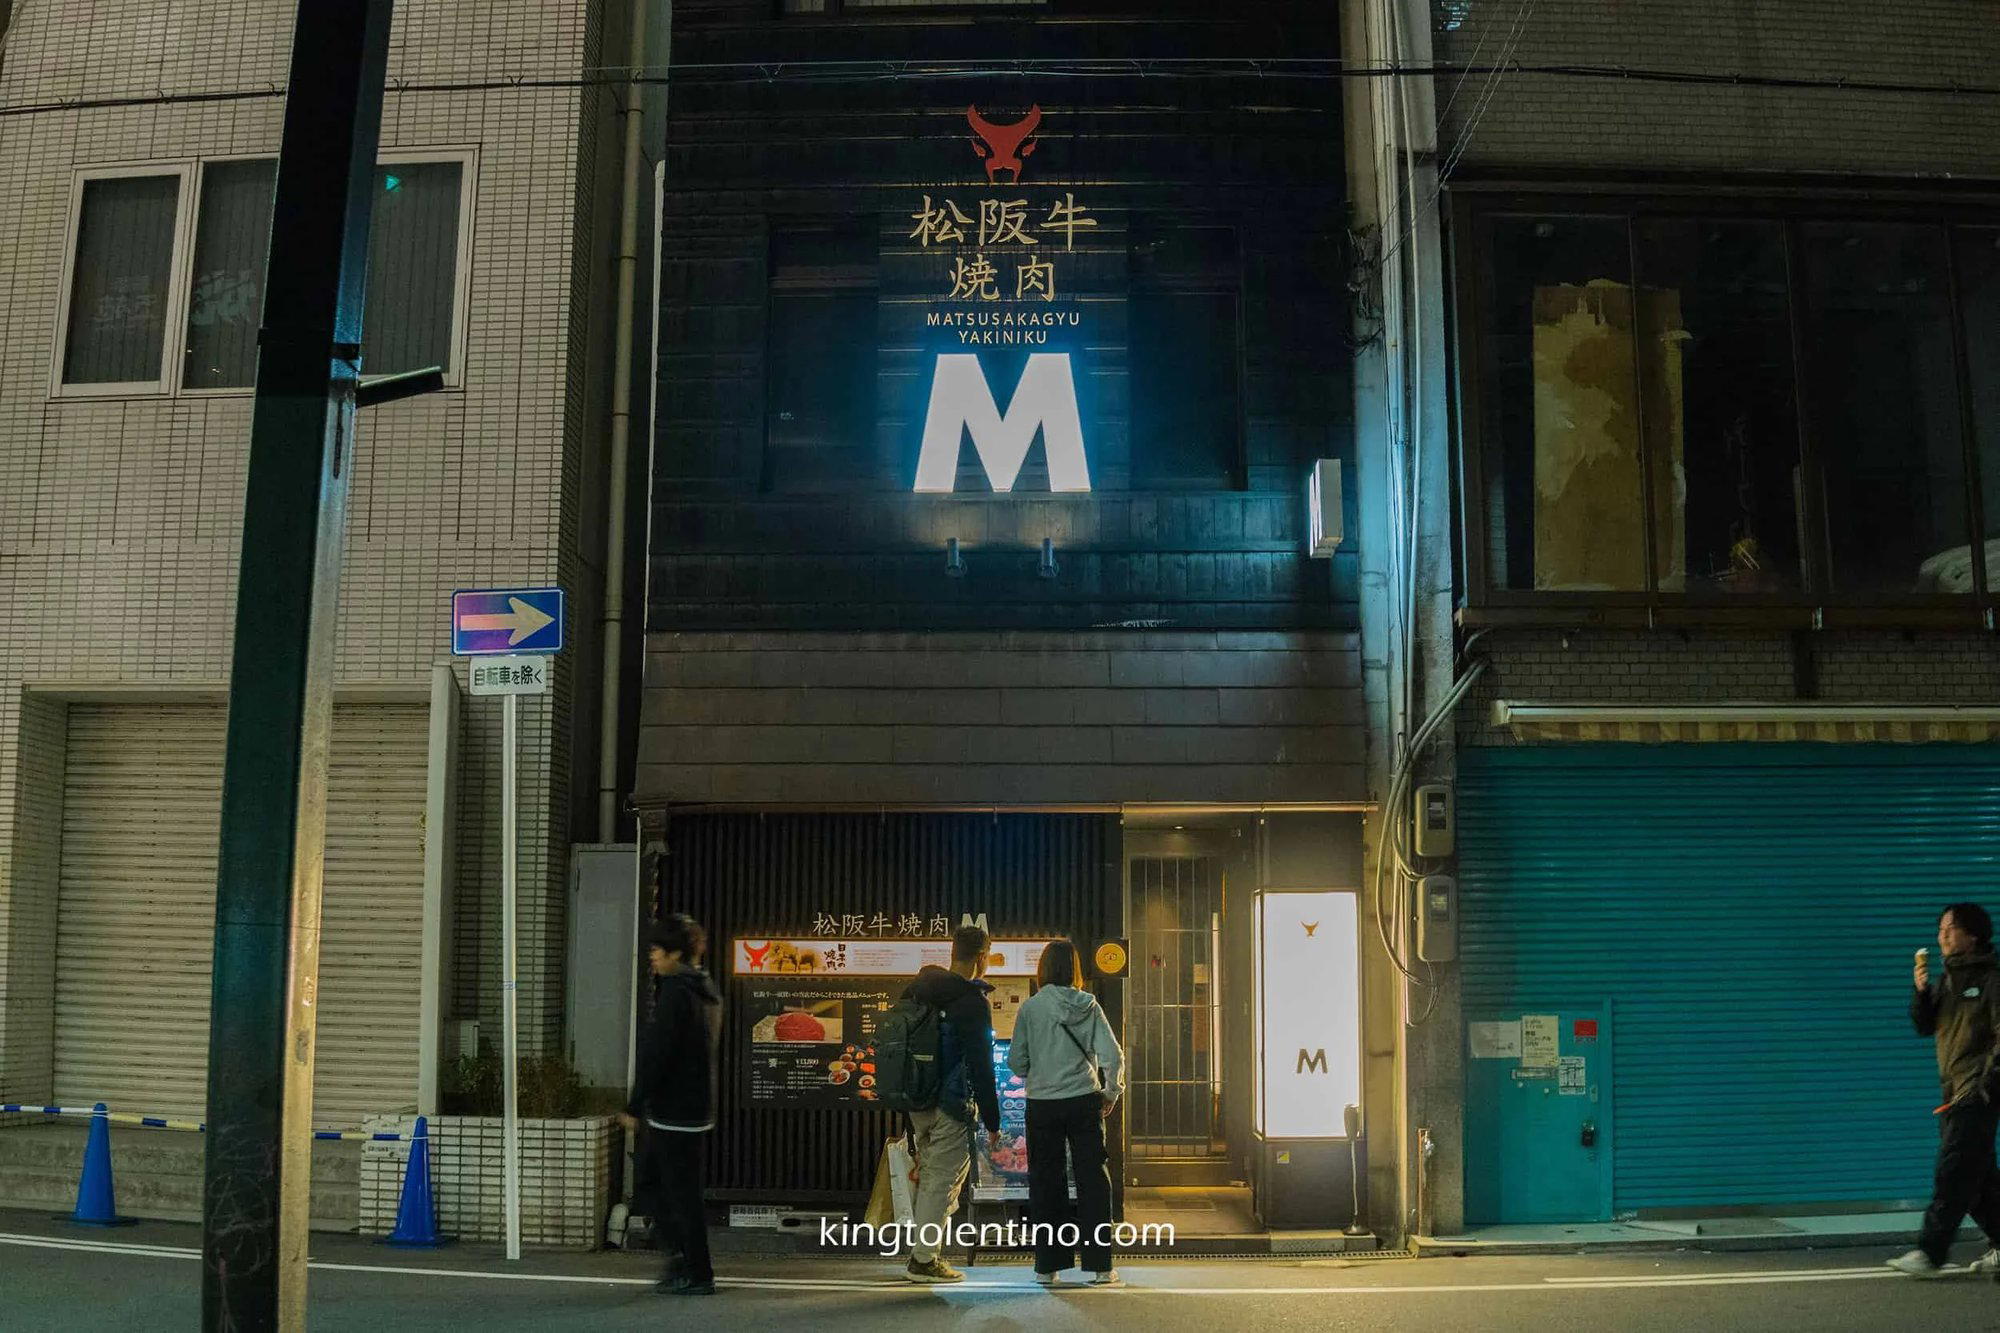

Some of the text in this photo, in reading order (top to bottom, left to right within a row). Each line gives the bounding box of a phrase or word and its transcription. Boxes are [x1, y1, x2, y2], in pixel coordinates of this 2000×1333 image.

[910, 193, 1097, 251] 松阪牛
[948, 254, 1055, 303] 焼肉
[927, 312, 1080, 326] MATSUSAKAGYU
[958, 330, 1047, 344] YAKINIKU
[913, 352, 1092, 493] M
[474, 665, 542, 686] 自転車を除く
[813, 912, 990, 938] 松阪牛焼肉 M
[1296, 1048, 1328, 1074] M
